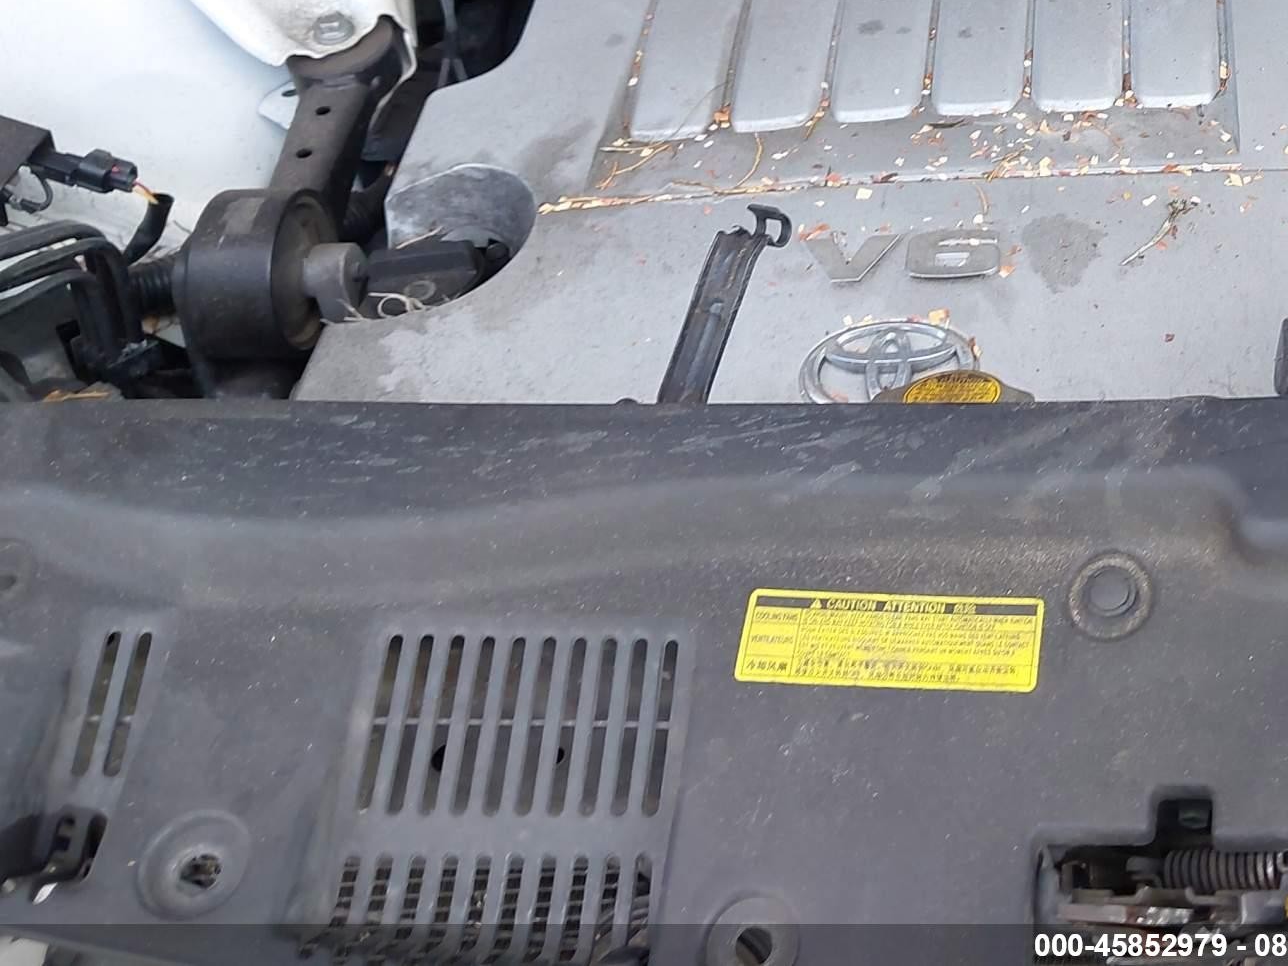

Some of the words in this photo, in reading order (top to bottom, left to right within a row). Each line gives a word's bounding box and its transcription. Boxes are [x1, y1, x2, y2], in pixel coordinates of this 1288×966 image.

[804, 229, 1001, 283] V6
[826, 599, 877, 612] CAUTION
[883, 601, 946, 614] ATTENTION
[755, 610, 783, 621] COOLING
